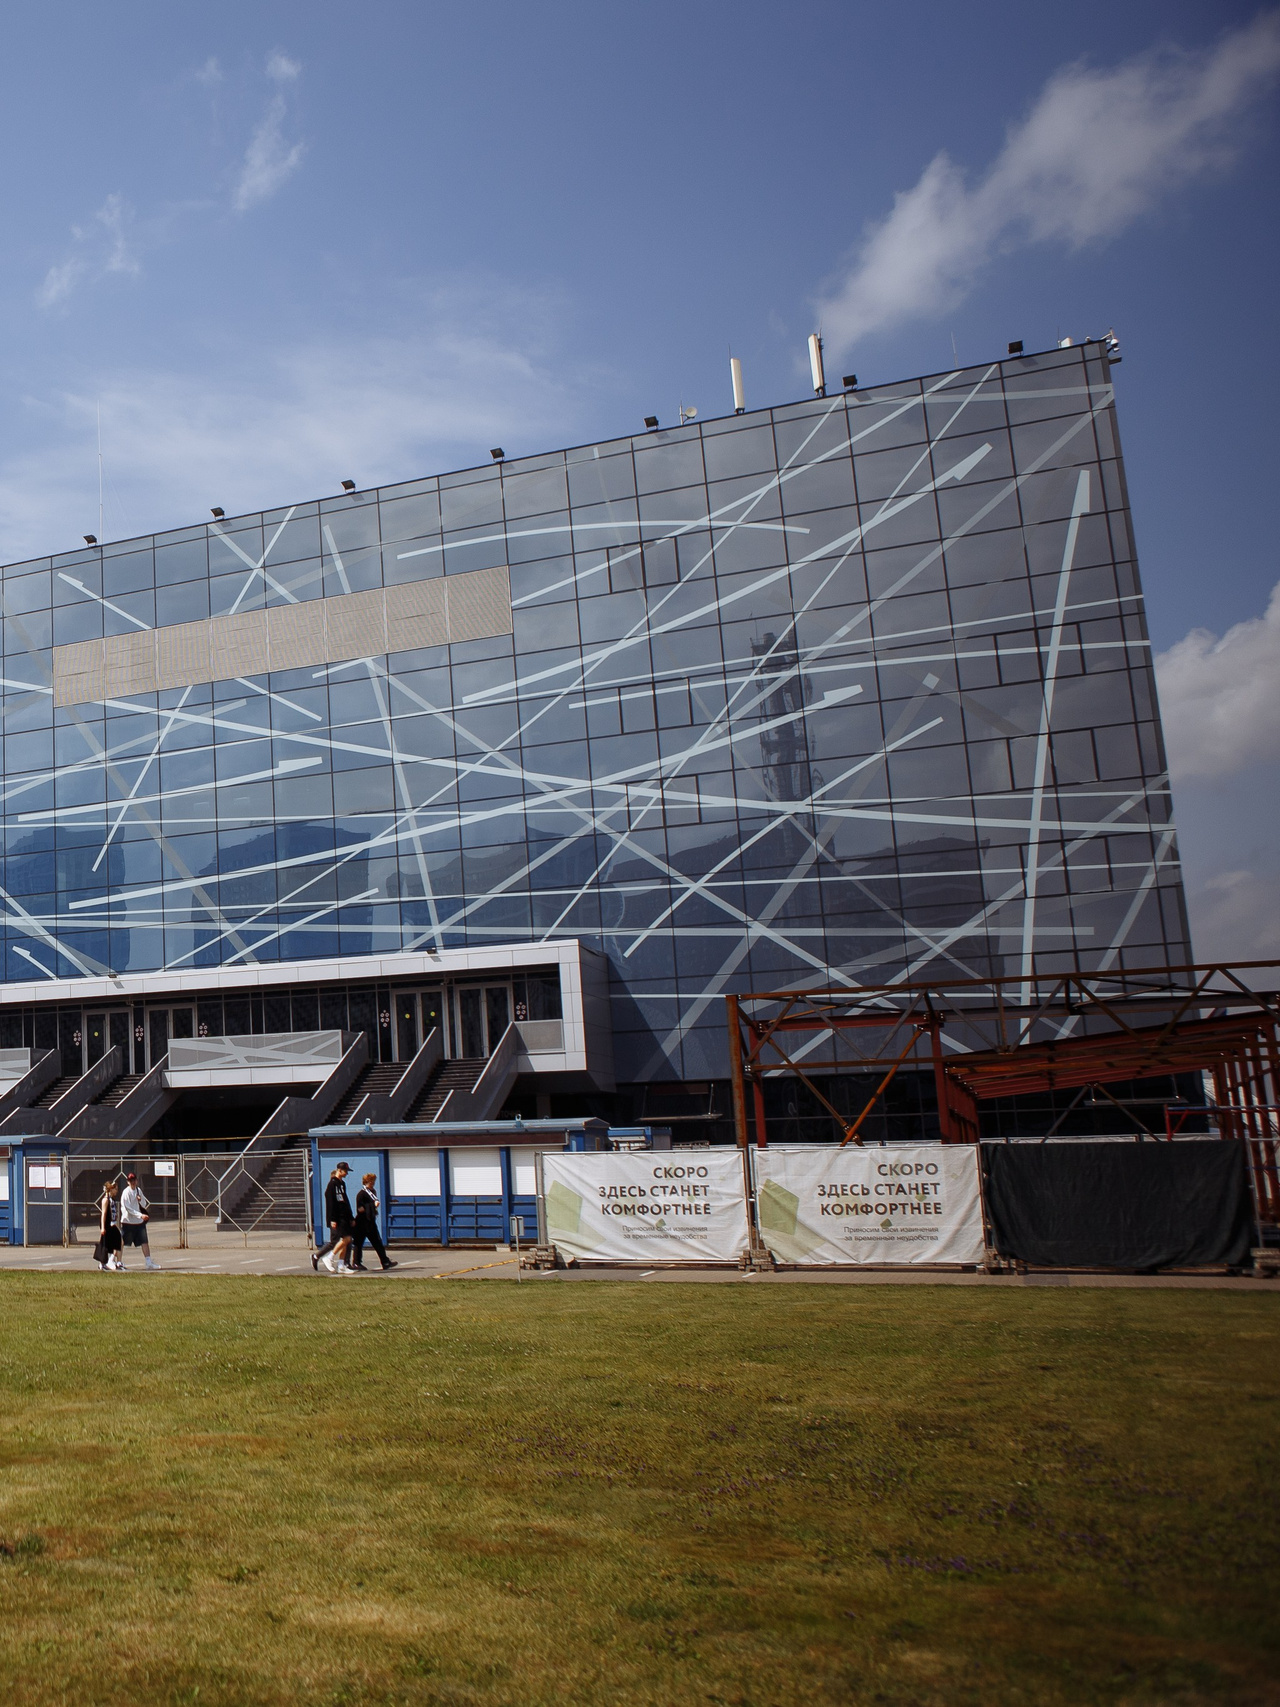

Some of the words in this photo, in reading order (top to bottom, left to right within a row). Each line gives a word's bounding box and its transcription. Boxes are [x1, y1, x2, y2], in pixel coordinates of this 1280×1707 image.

[653, 1166, 708, 1179] СКОРО
[877, 1163, 939, 1176] СКОРО
[598, 1186, 646, 1199] ЗДЕСЬ
[650, 1184, 710, 1197] СТАНЕТ
[817, 1184, 870, 1198] ЗДЕСЬ
[874, 1182, 941, 1196] СТАНЕТ
[601, 1203, 711, 1216] КОМФОРТНЕЕ
[820, 1202, 942, 1216] КОМФОРТНЕЕ
